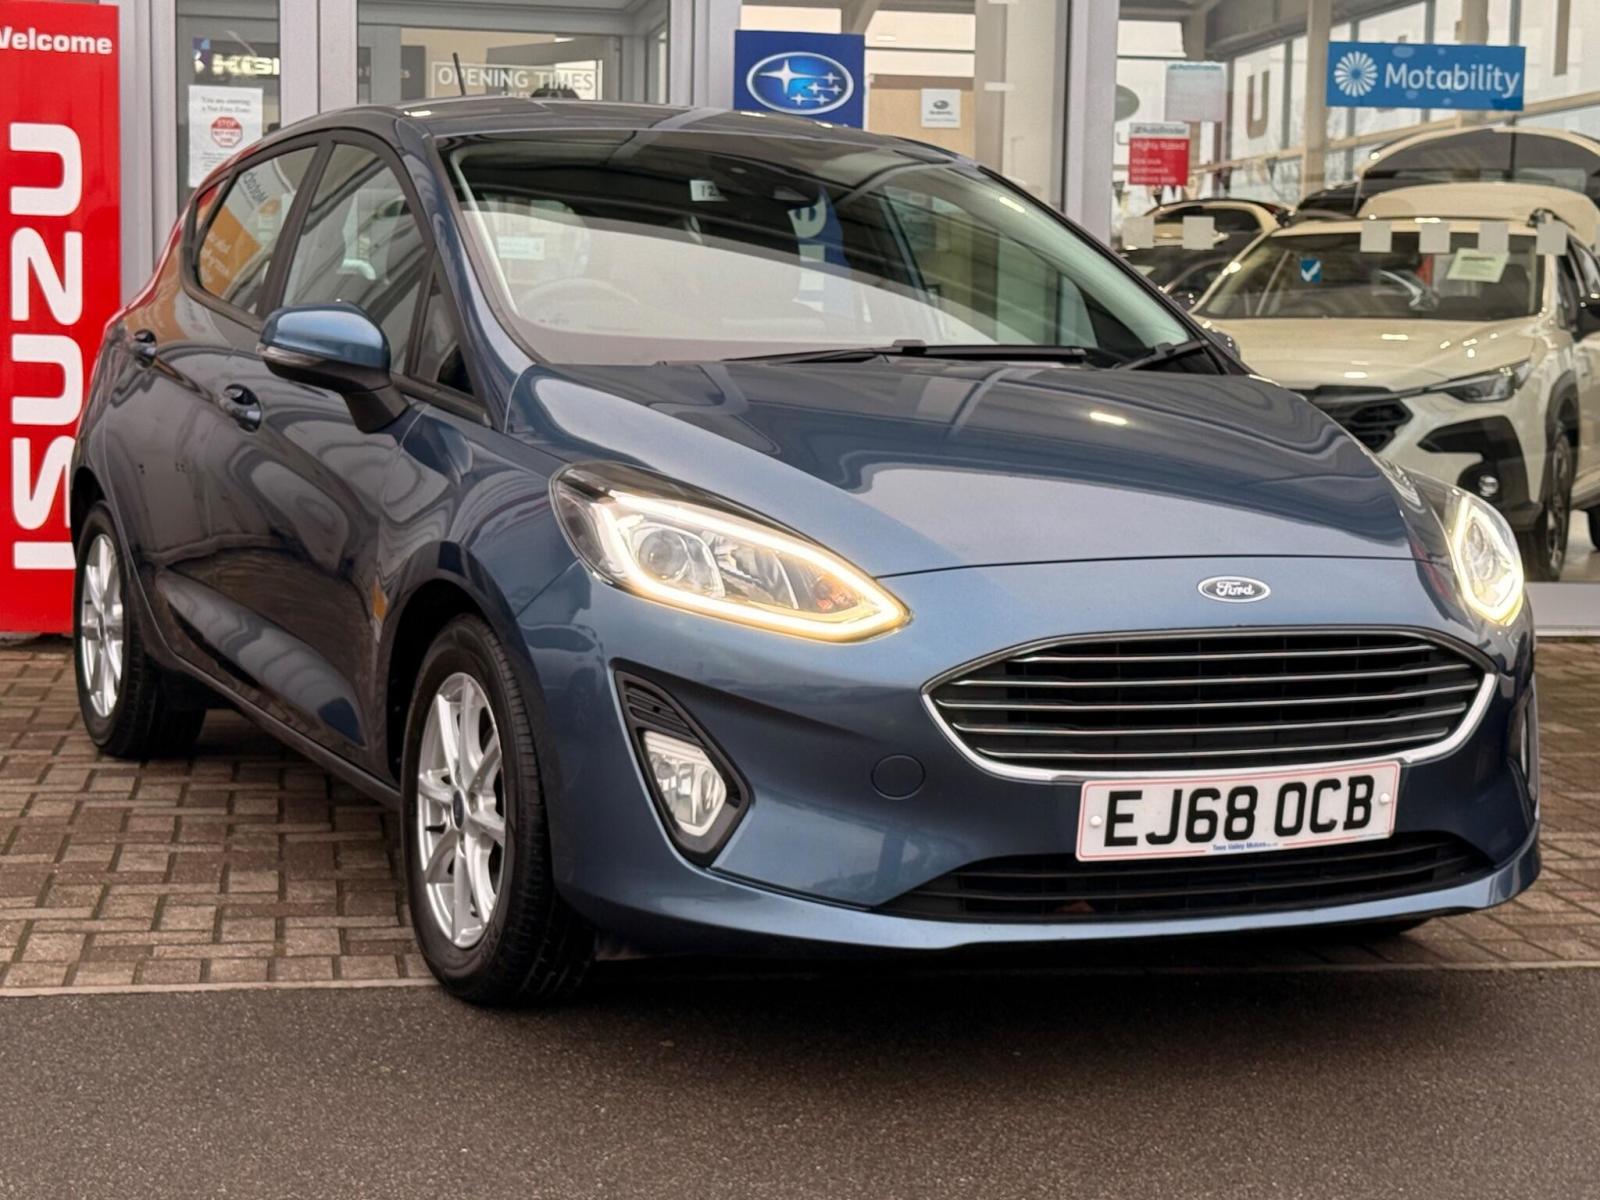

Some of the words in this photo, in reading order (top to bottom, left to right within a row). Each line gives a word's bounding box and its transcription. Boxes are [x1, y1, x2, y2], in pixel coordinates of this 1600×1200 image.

[437, 66, 529, 89] OPENING
[536, 70, 594, 91] TIMES
[1384, 62, 1521, 98] Motability
[9, 122, 84, 569] ISUZU
[1215, 581, 1255, 597] Ford
[1104, 785, 1258, 847] EJ68
[1274, 774, 1375, 837] OCB
